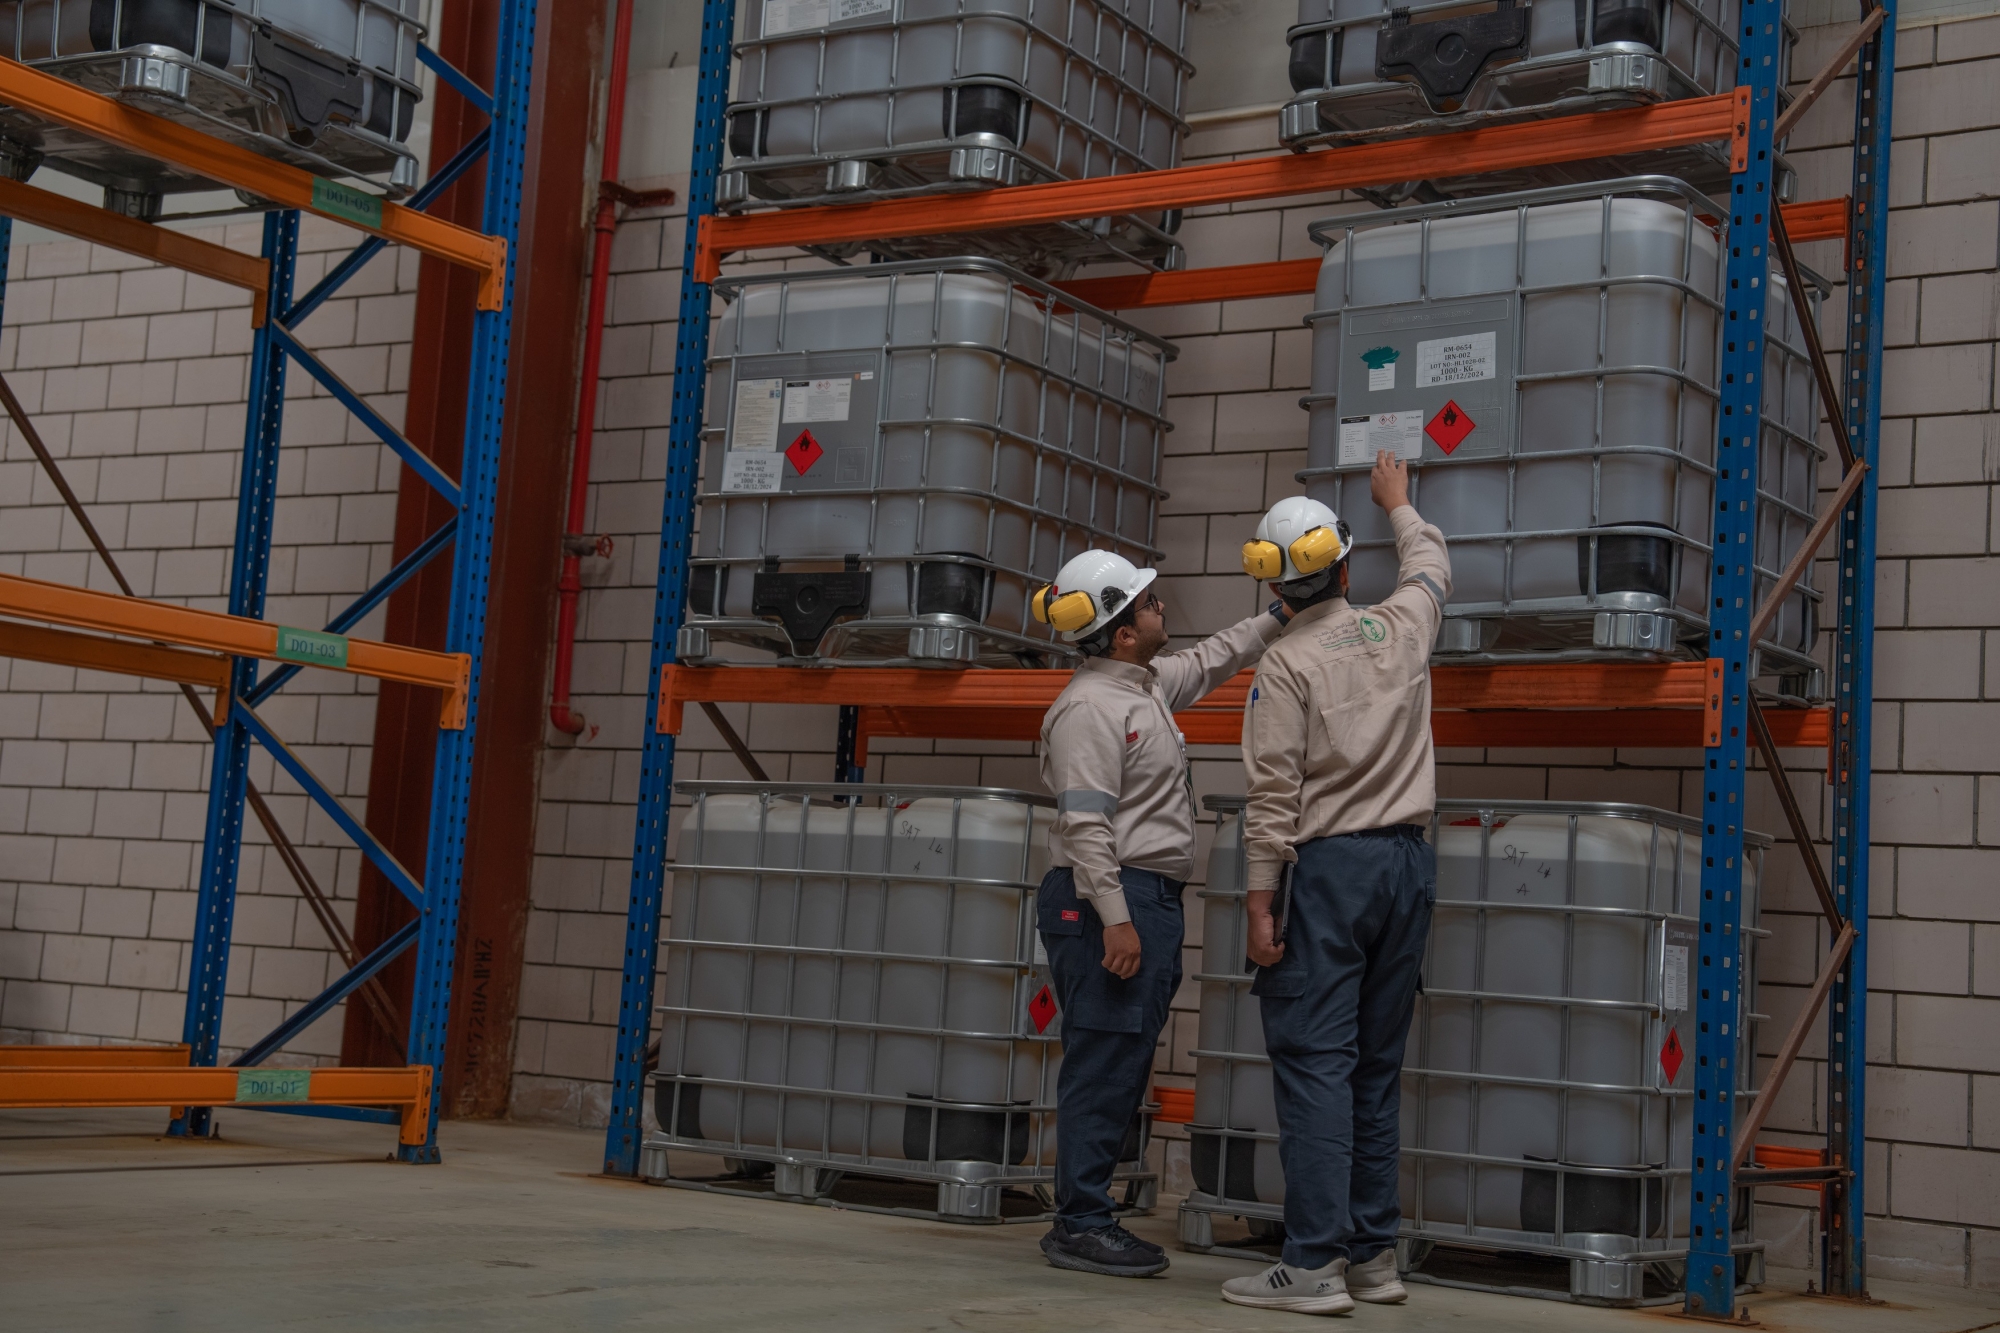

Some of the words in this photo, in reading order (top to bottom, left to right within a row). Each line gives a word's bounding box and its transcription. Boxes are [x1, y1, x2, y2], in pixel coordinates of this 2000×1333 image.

[326, 188, 370, 212] D01-05
[1444, 344, 1472, 353] RM-0654
[1445, 352, 1471, 360] IRN-002
[1441, 367, 1458, 375] 1000
[1445, 371, 1484, 381] 18/12/2024
[291, 639, 336, 658] D01-03
[900, 820, 920, 842] SAT
[1502, 844, 1529, 867] SAT
[913, 861, 920, 873] A
[1516, 883, 1530, 896] A
[252, 1081, 295, 1094] D01-01
